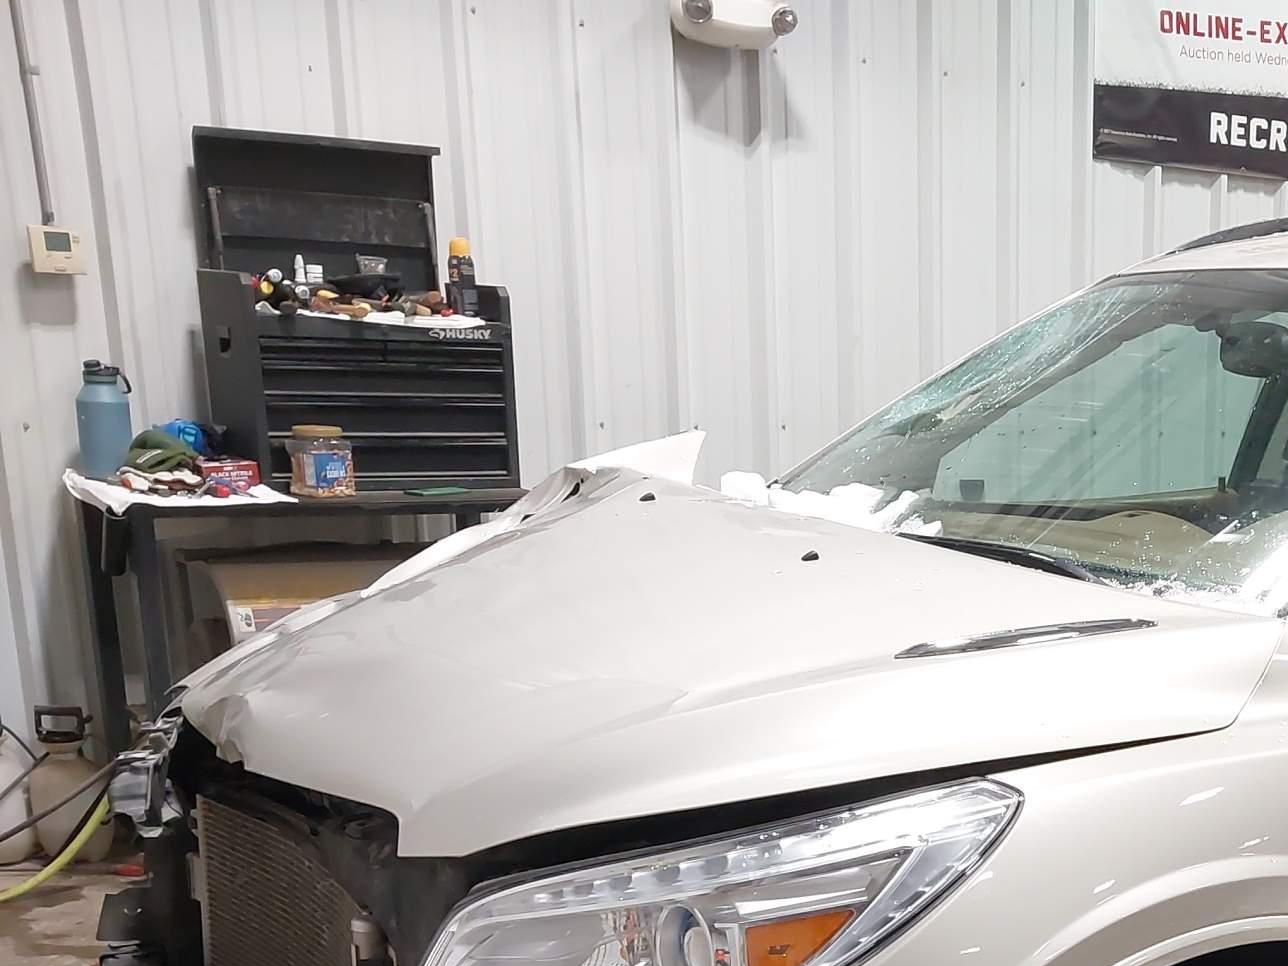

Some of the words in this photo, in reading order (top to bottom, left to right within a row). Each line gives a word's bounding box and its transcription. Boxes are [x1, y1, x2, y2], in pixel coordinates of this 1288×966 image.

[1179, 45, 1223, 61] Auction
[1227, 51, 1251, 63] held
[446, 328, 492, 340] HUSKY
